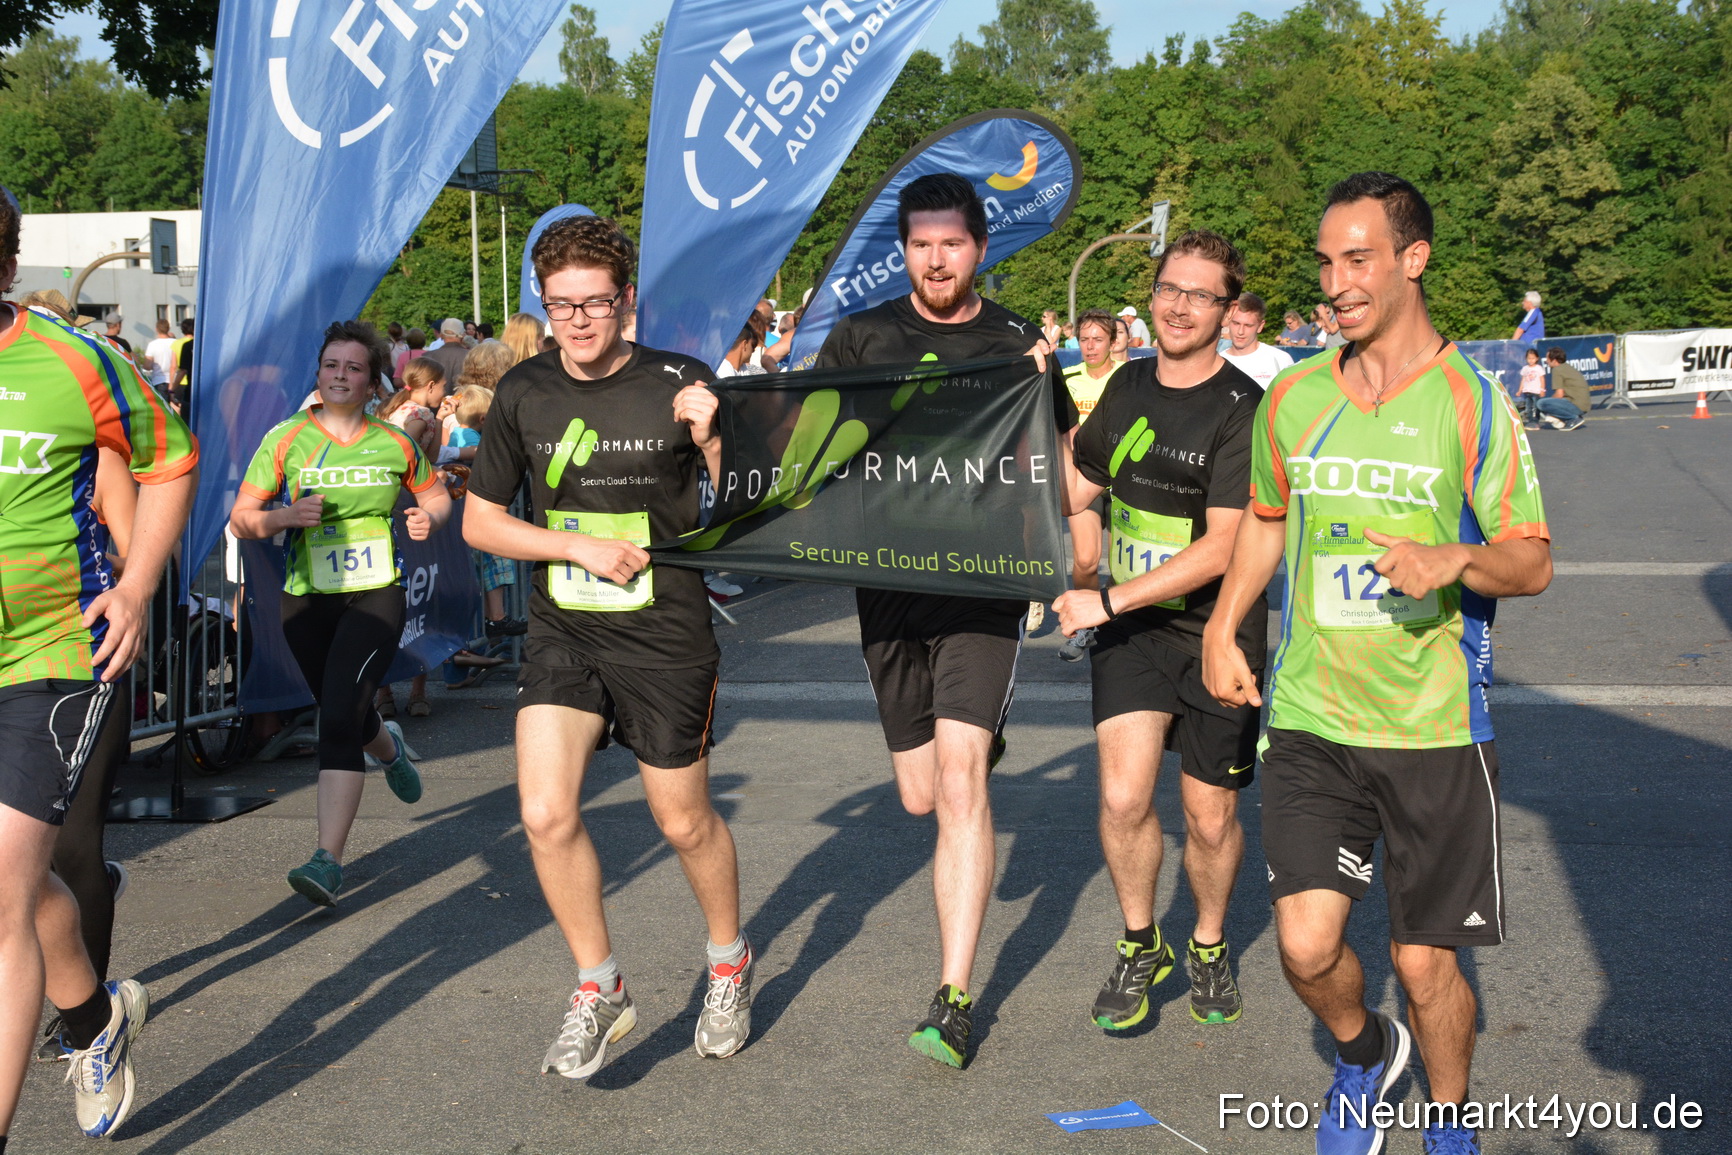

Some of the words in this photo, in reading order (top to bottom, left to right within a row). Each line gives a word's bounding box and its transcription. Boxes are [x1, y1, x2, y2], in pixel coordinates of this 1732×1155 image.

[330, 0, 438, 90] Fi
[724, 0, 866, 169] Fisch
[988, 214, 1013, 234] und
[1013, 181, 1064, 221] Medien
[299, 466, 393, 489] BOCK
[581, 477, 606, 487] Secure
[607, 476, 627, 486] Cloud
[1131, 473, 1153, 487] Secure
[1153, 479, 1169, 491] Cloud
[1170, 482, 1203, 495] Slutions
[1286, 456, 1444, 507] BOCK
[1324, 535, 1365, 546] firmenlauf
[325, 546, 373, 573] 151
[790, 541, 870, 567] Secure
[877, 547, 939, 572] Cloud
[947, 552, 1055, 577] Solutions
[577, 589, 598, 597] Marcus
[1340, 608, 1387, 619] Christopher
[1388, 605, 1410, 615] Groß
[1463, 919, 1487, 927] adidas
